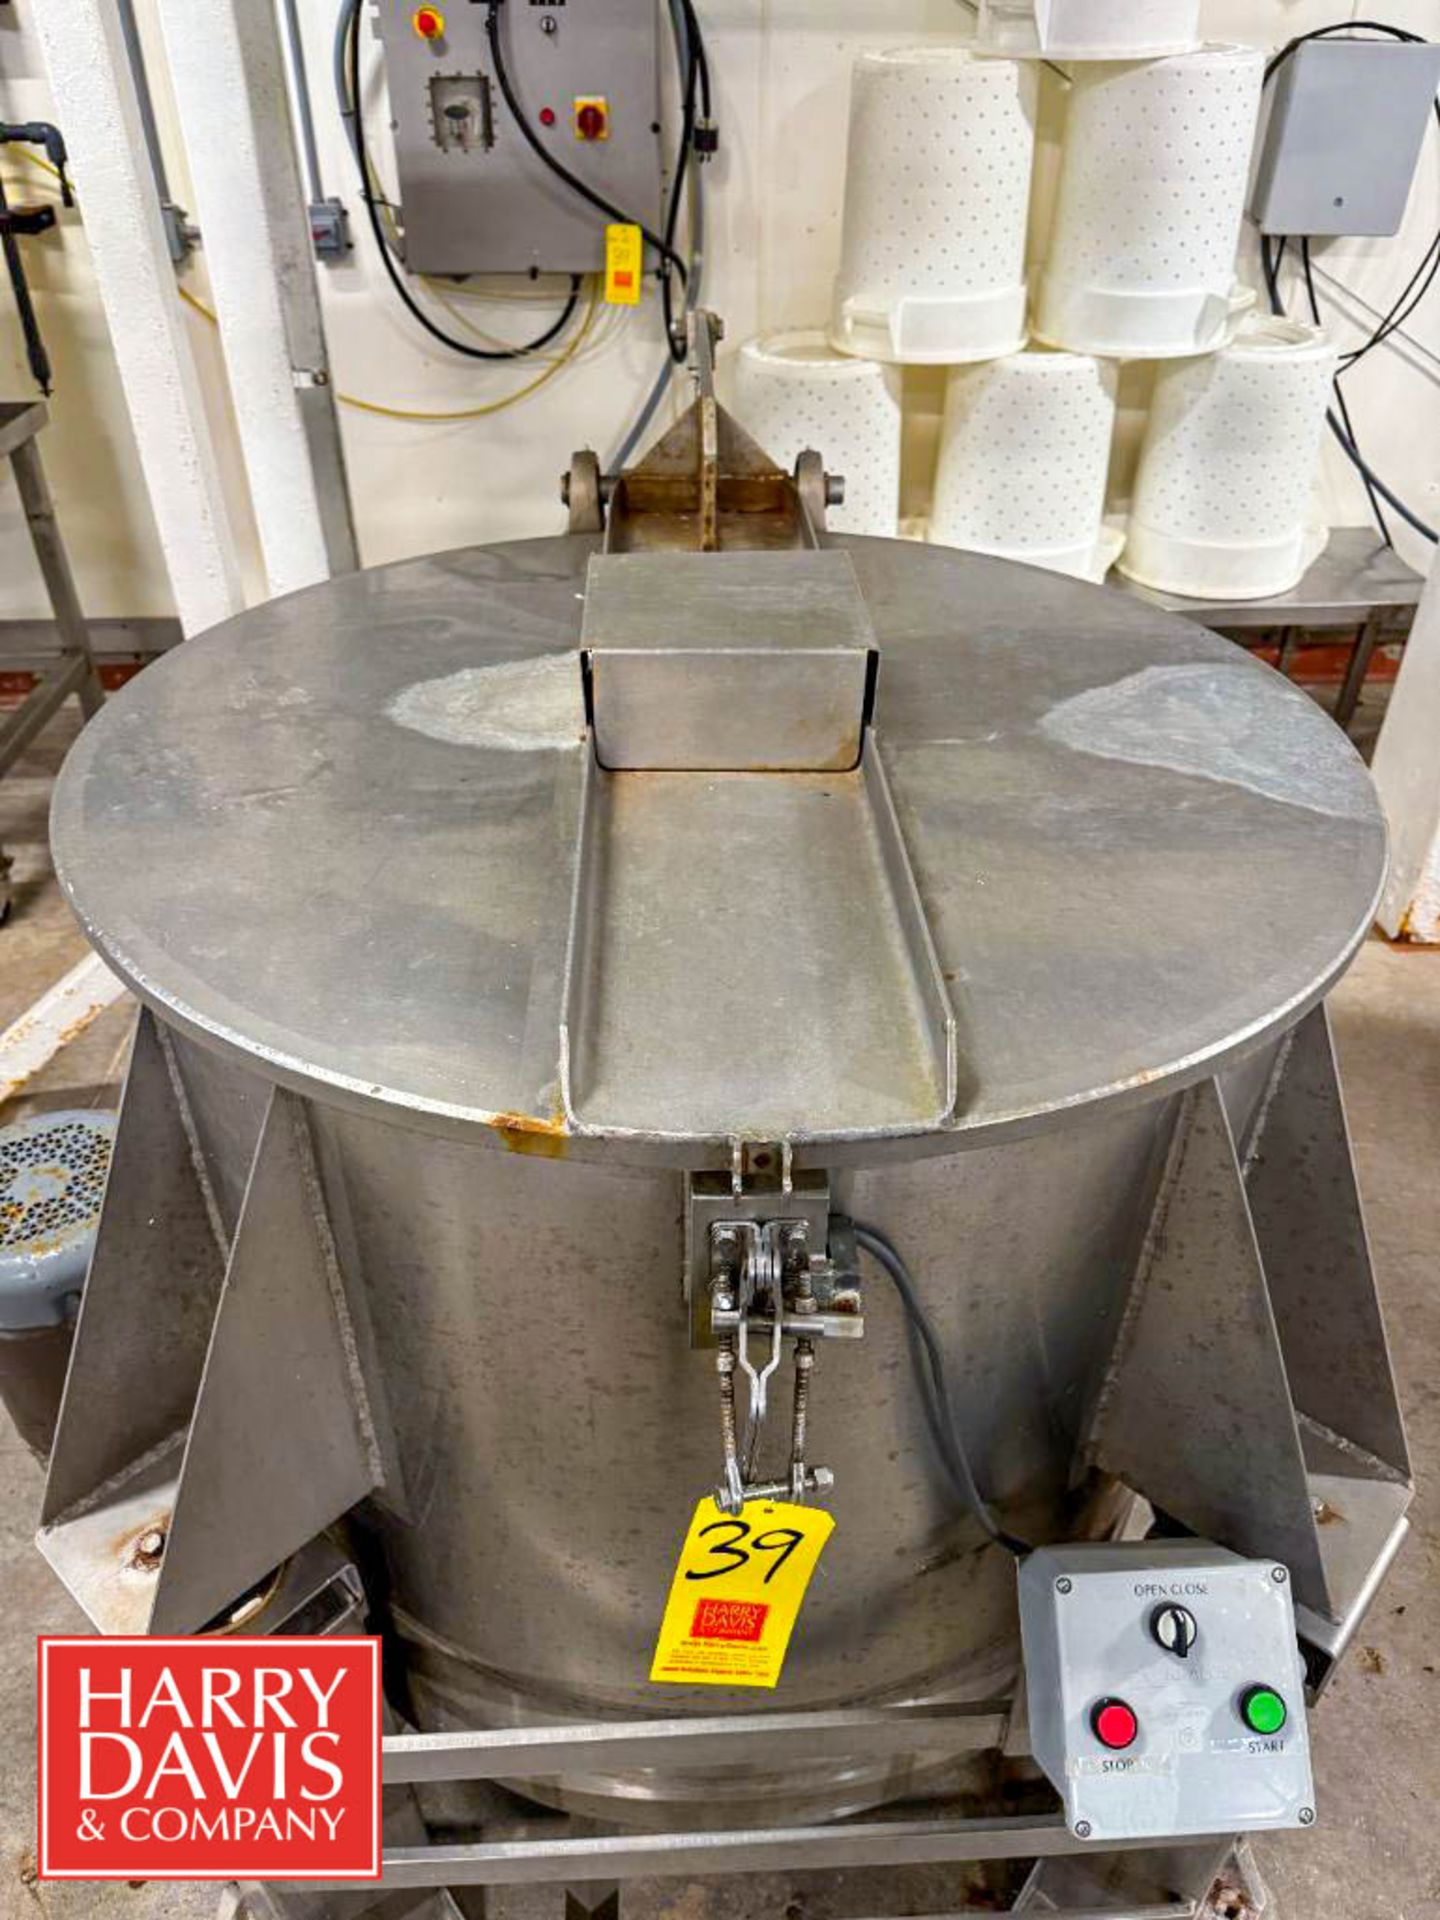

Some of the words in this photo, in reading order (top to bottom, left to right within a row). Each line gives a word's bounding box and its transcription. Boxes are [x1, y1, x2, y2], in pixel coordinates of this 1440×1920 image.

[685, 1520, 805, 1584] 39
[1133, 1583, 1168, 1597] OPEN
[1169, 1582, 1209, 1596] CLOSE
[703, 1602, 763, 1619] HARRY
[702, 1611, 756, 1629] DAVIS
[1247, 1740, 1285, 1754] START
[1102, 1759, 1134, 1773] STOP
